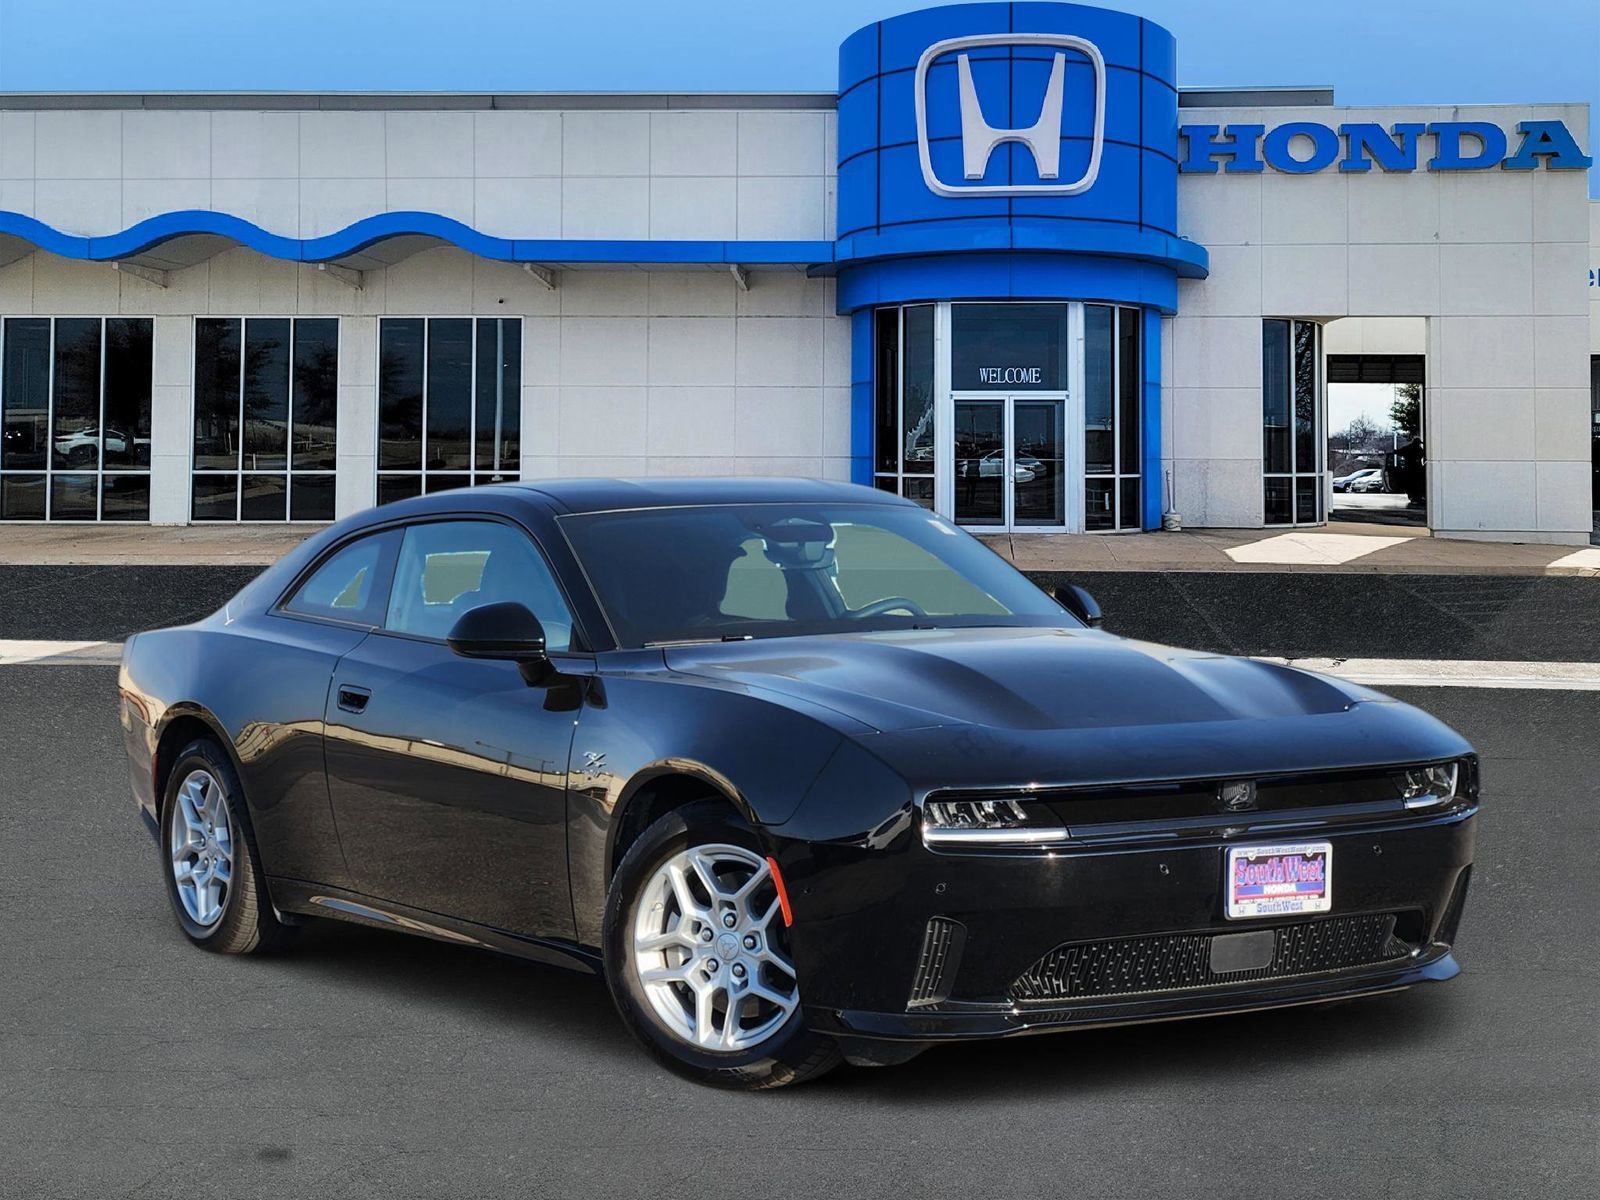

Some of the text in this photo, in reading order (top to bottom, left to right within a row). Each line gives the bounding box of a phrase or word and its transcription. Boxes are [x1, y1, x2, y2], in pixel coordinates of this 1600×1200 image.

[1178, 121, 1592, 174] HONDA
[979, 367, 1041, 384] WELCOME
[1263, 882, 1297, 895] HONDA
